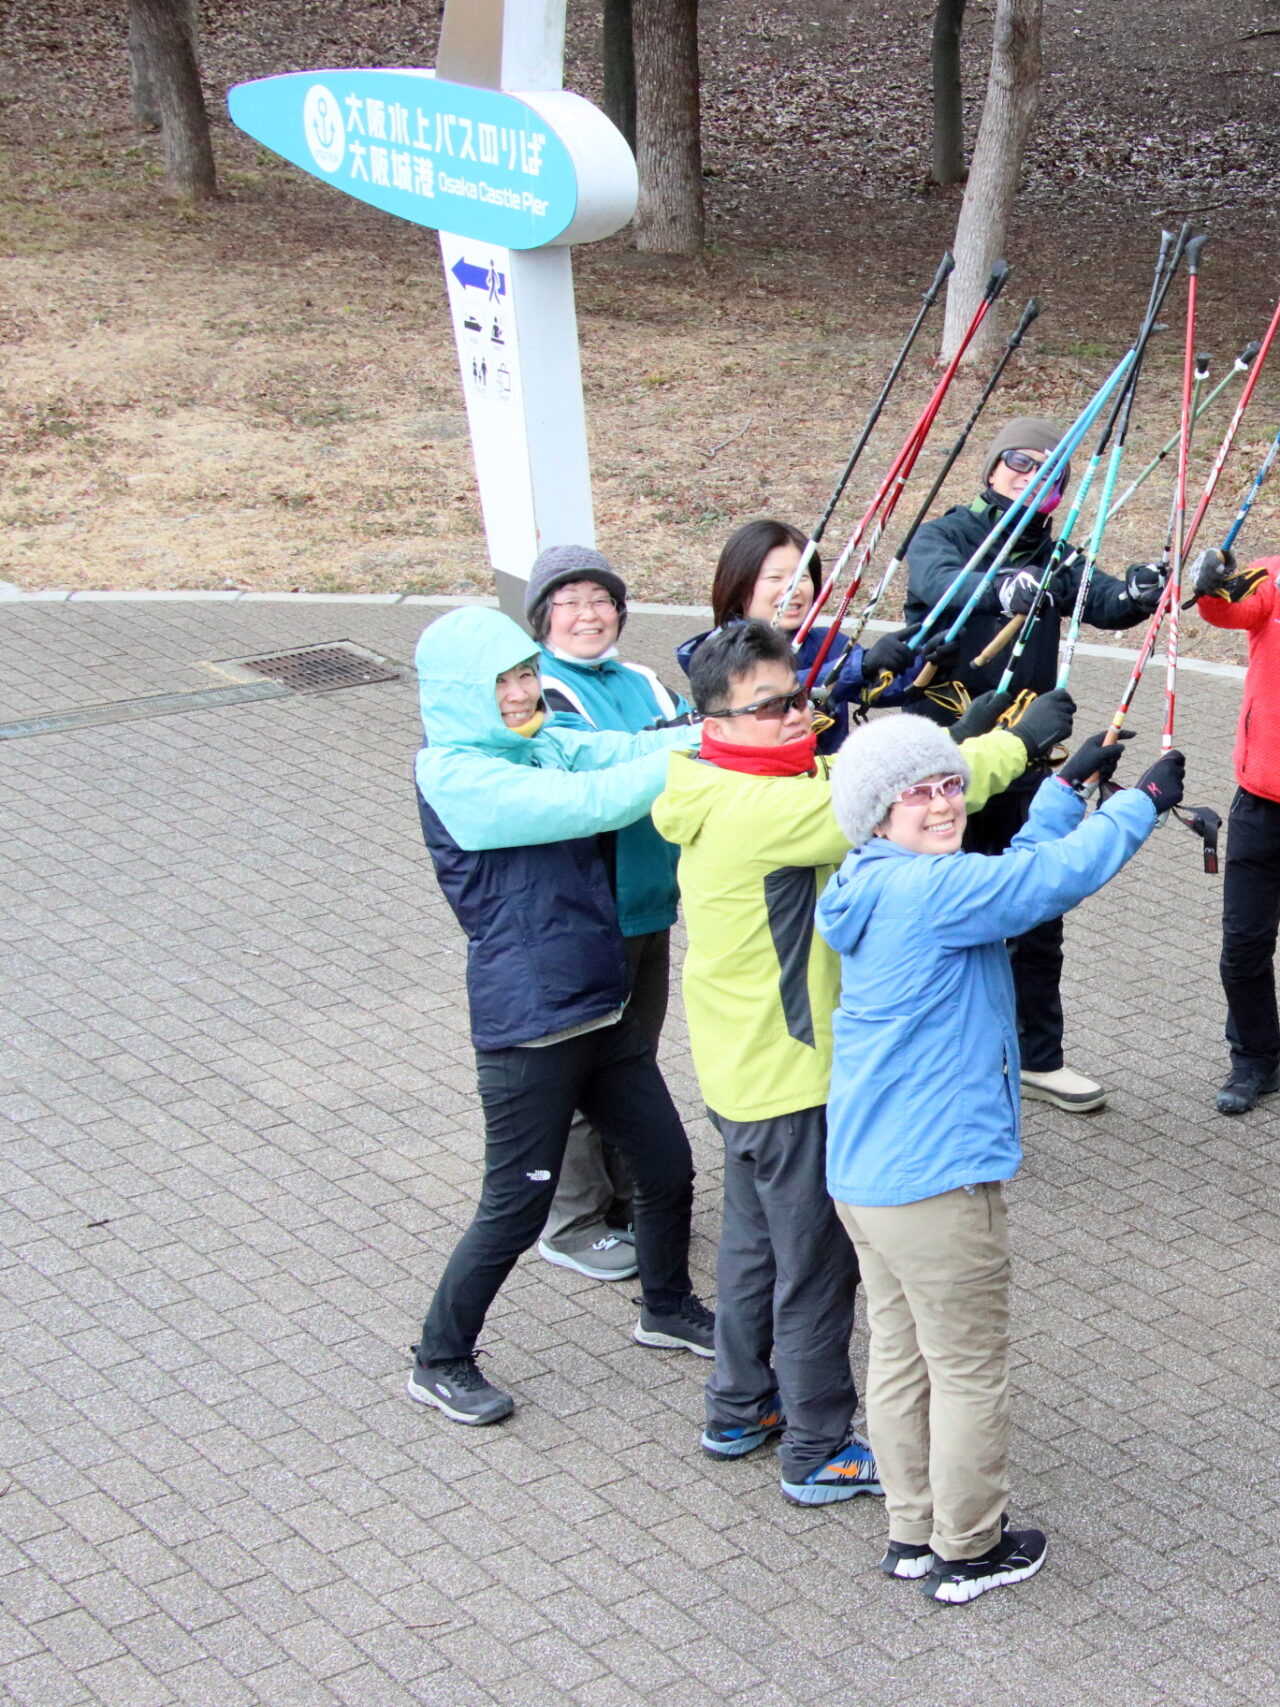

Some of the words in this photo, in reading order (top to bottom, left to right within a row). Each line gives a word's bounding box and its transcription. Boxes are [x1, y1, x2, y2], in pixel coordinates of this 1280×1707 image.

[344, 92, 546, 176] 大阪水上バスのりば
[348, 139, 435, 198] 大阪城港
[438, 171, 478, 200] Osaka
[478, 181, 522, 210] Castle
[522, 191, 549, 217] Pier
